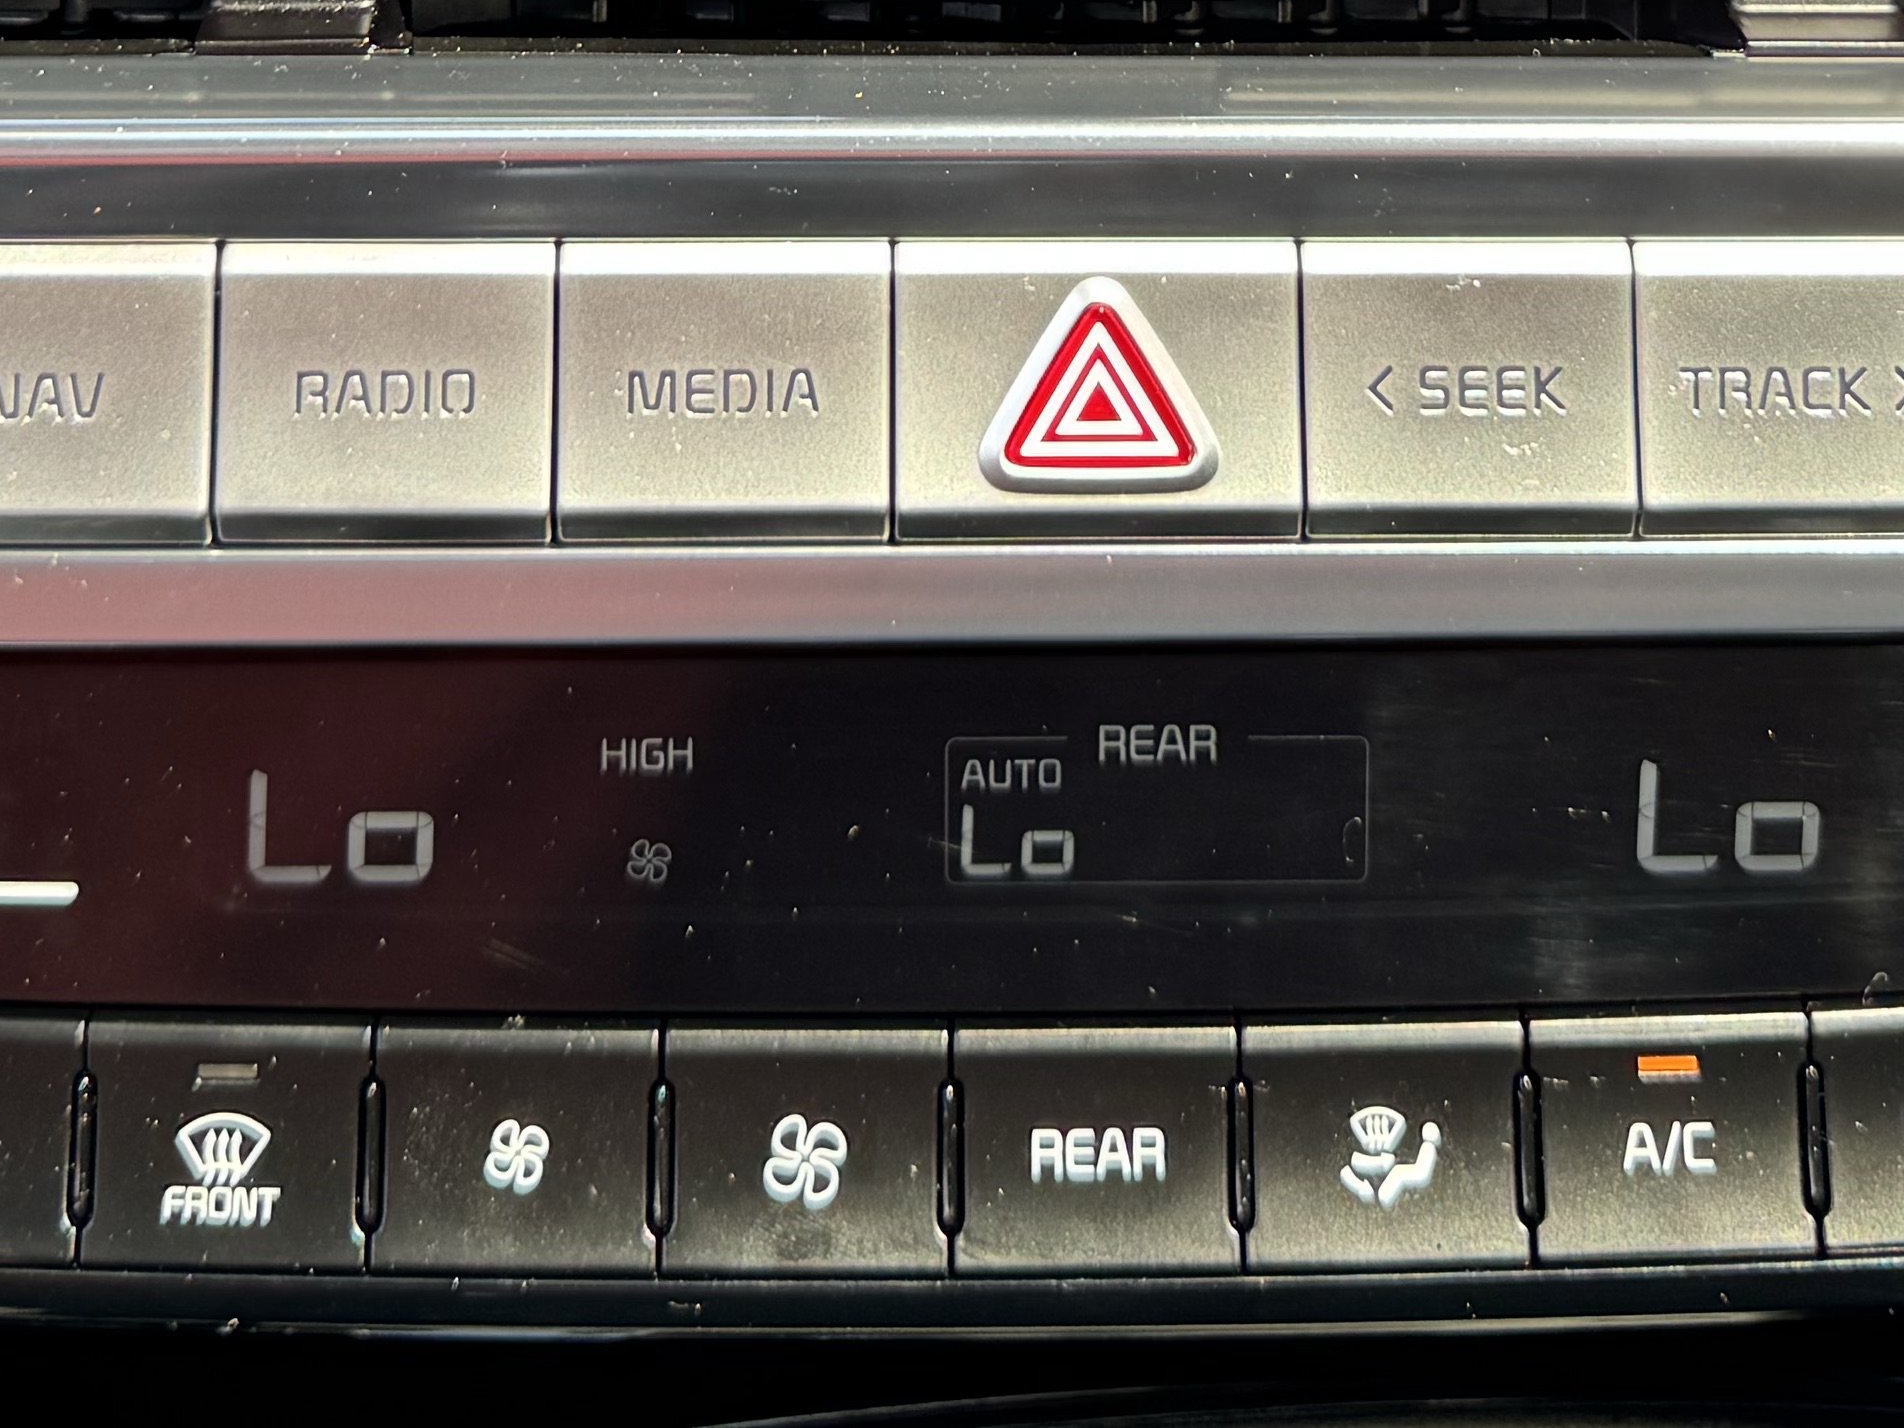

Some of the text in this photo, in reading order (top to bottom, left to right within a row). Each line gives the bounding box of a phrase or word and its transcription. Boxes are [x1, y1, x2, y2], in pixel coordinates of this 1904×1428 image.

[292, 368, 478, 417] RADIO
[624, 367, 820, 415] MEDIA
[1418, 366, 1566, 414] SEEK
[1680, 366, 1872, 414] TRACK
[601, 737, 692, 771] HIGH
[1099, 725, 1216, 762] REAR
[962, 759, 1061, 789] AUTO
[248, 770, 434, 883] Lo
[961, 805, 1074, 877] Lo
[1637, 760, 1820, 874] Lo
[1031, 1128, 1165, 1182] REAR
[1624, 1121, 1717, 1177] A/C
[160, 1184, 280, 1226] FRONT
